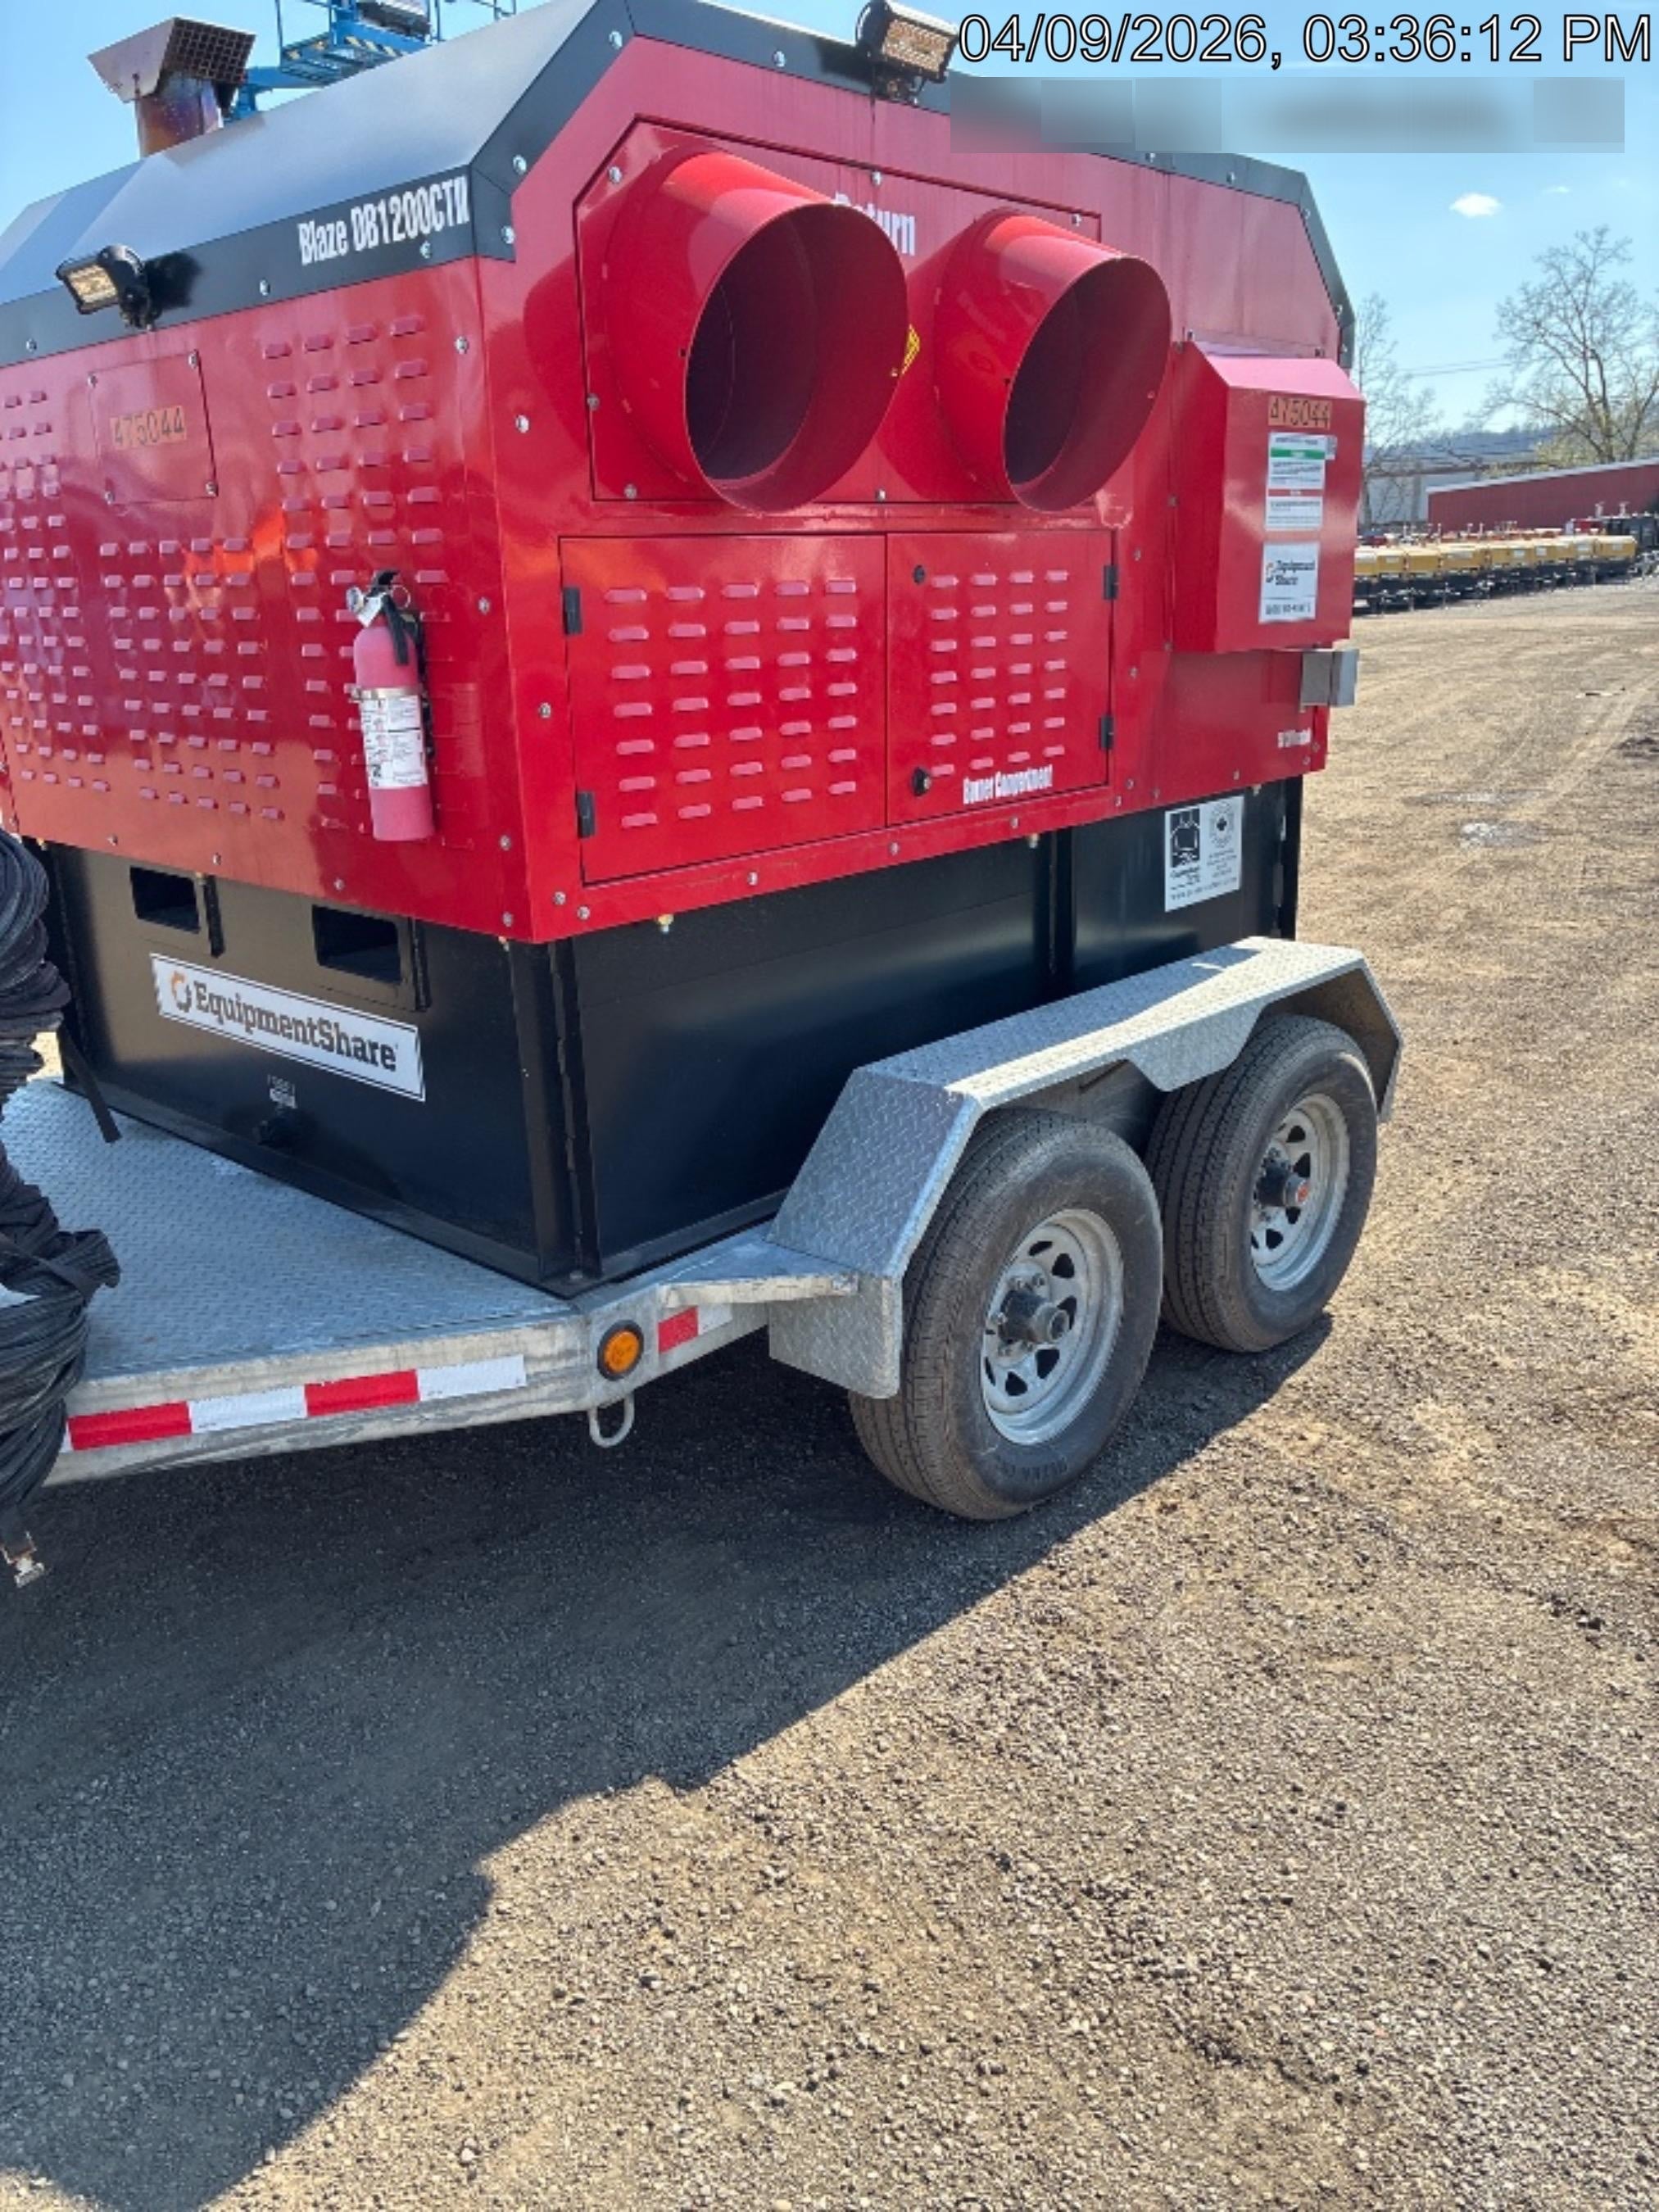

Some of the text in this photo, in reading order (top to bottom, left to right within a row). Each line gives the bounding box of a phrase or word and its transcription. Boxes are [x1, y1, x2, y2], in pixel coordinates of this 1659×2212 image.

[297, 219, 348, 266] Blaze
[115, 407, 185, 446] 475044
[1270, 398, 1330, 429] 475044
[963, 775, 994, 805] Burner
[193, 980, 397, 1072] EquipmentShare
